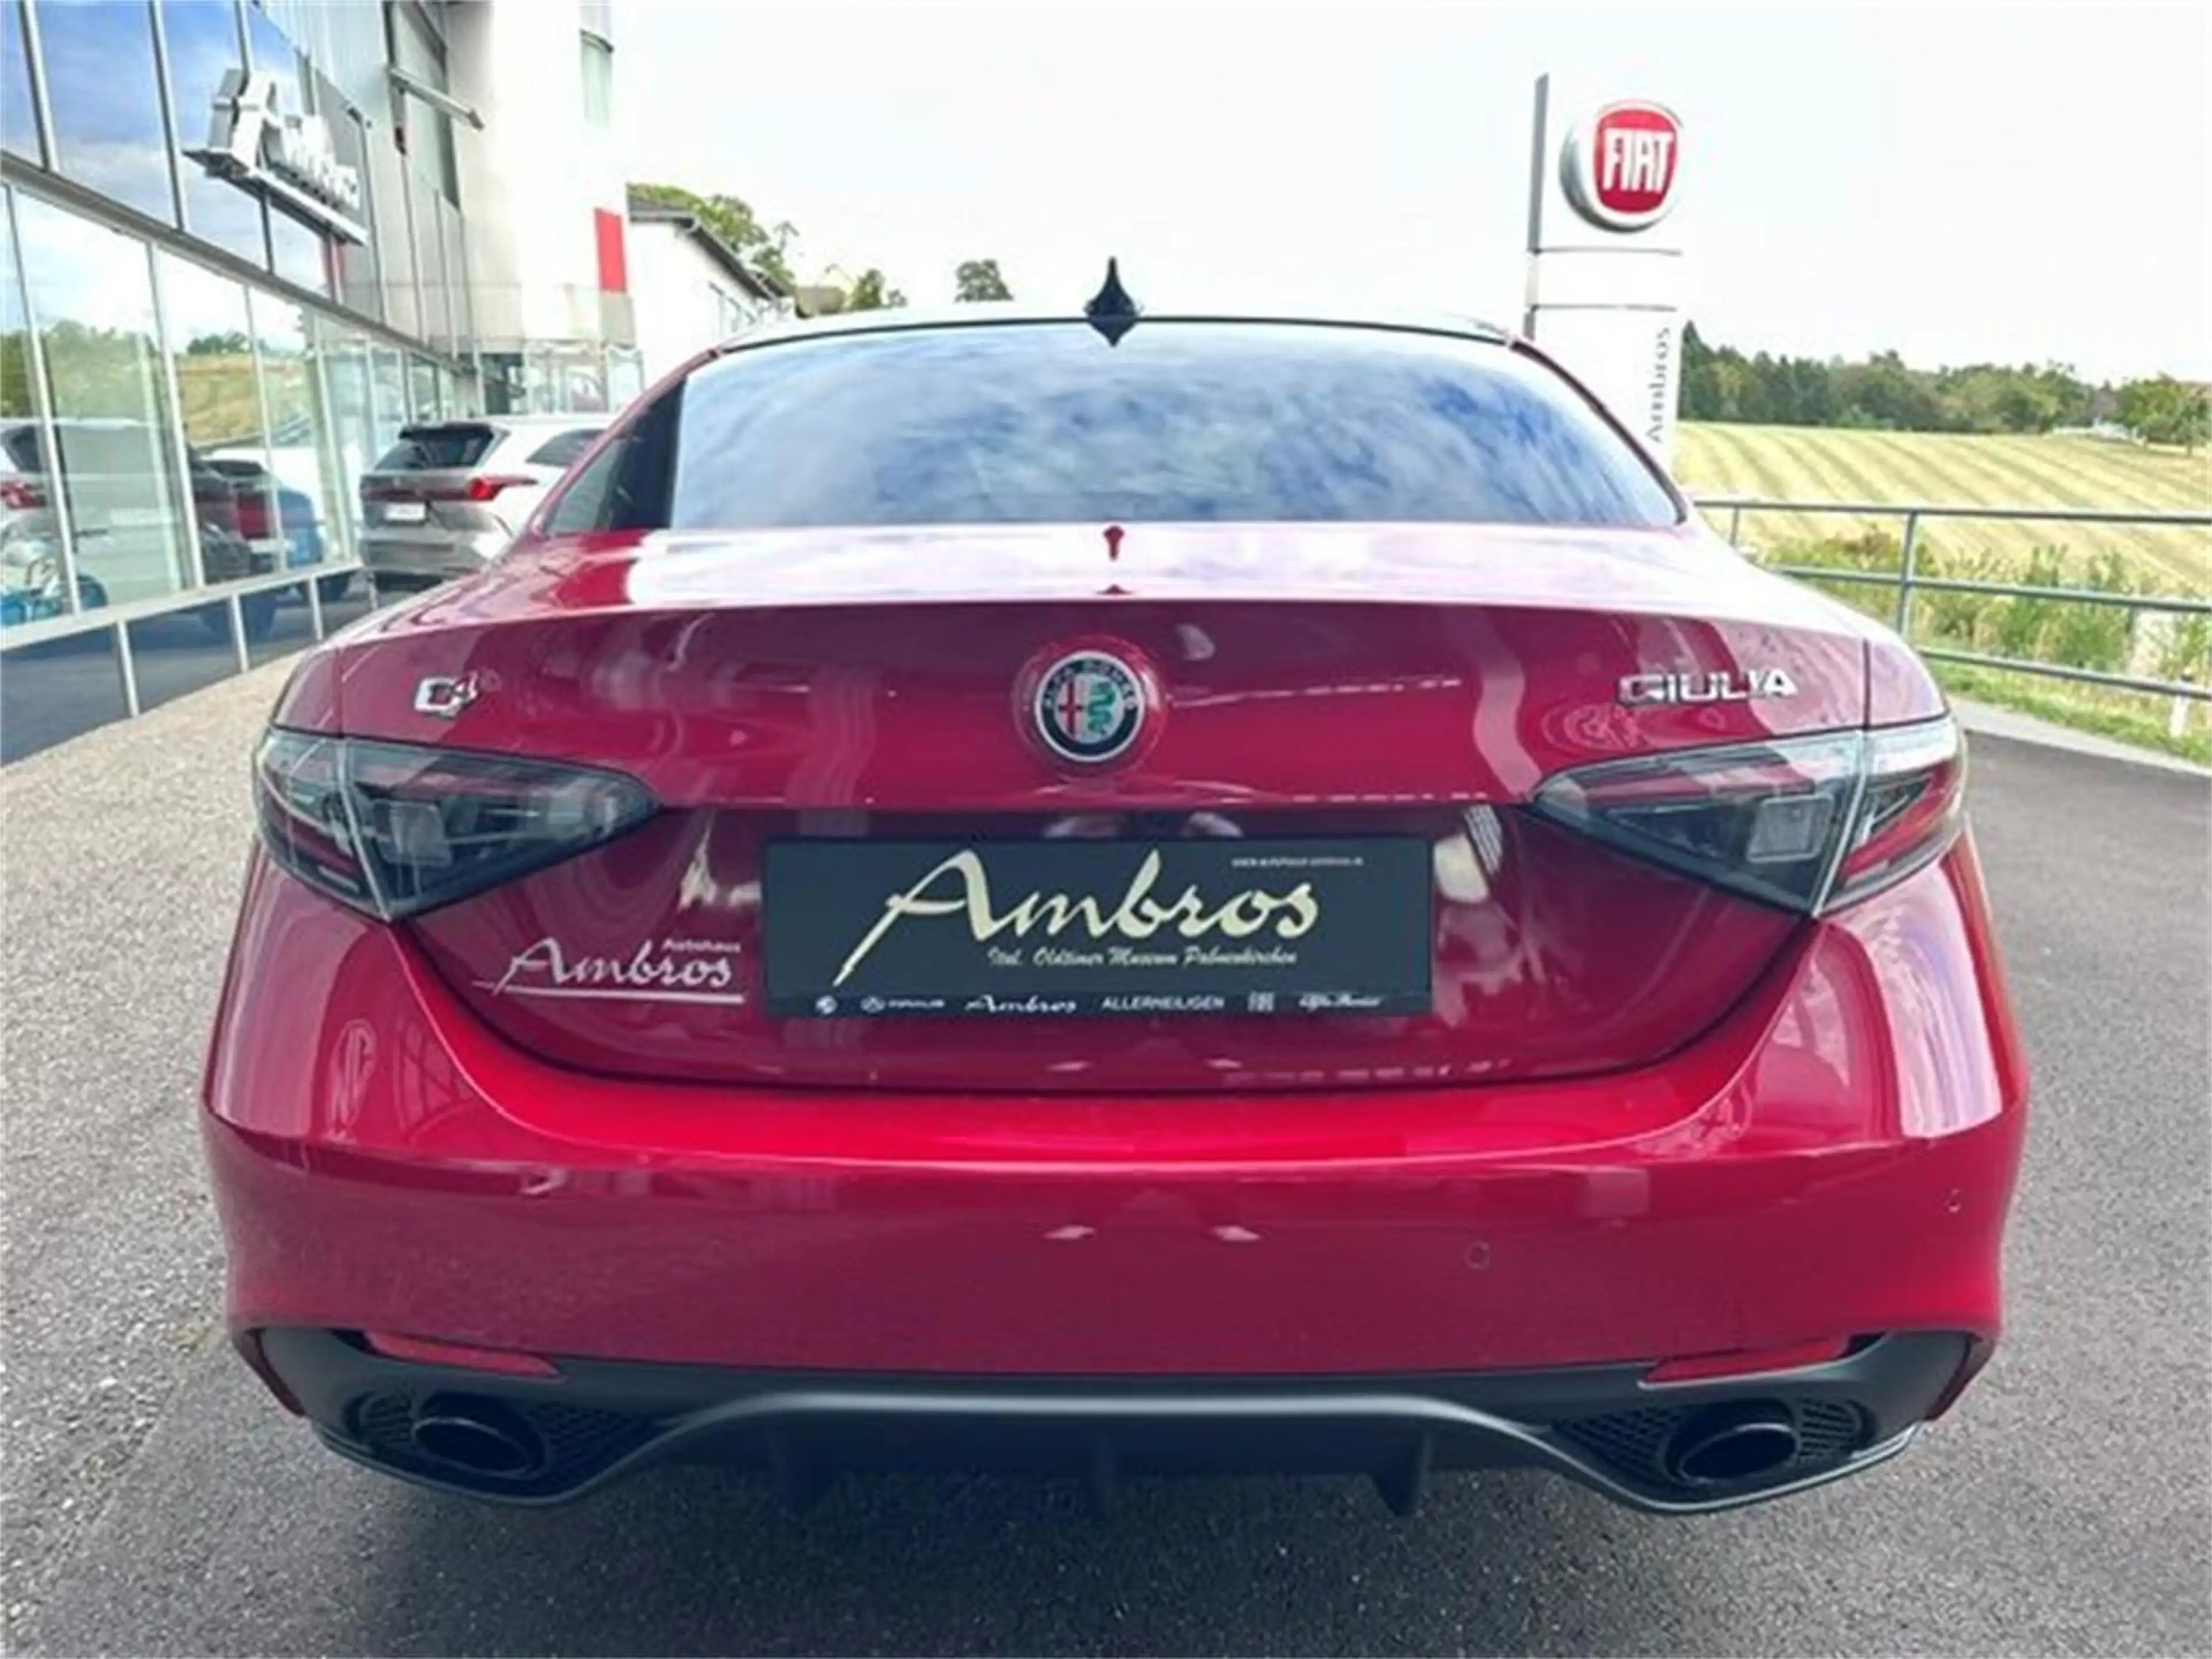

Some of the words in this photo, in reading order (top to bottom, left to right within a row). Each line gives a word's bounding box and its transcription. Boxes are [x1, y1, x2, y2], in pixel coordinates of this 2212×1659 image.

[1603, 127, 1673, 193] FIAT
[1645, 327, 1670, 444] Ambros
[1618, 668, 1799, 703] GIULIA
[663, 938, 742, 954] Autohaus
[834, 849, 1319, 986] Ambros
[491, 937, 732, 995] Ambros
[964, 994, 1077, 1013] Ambros
